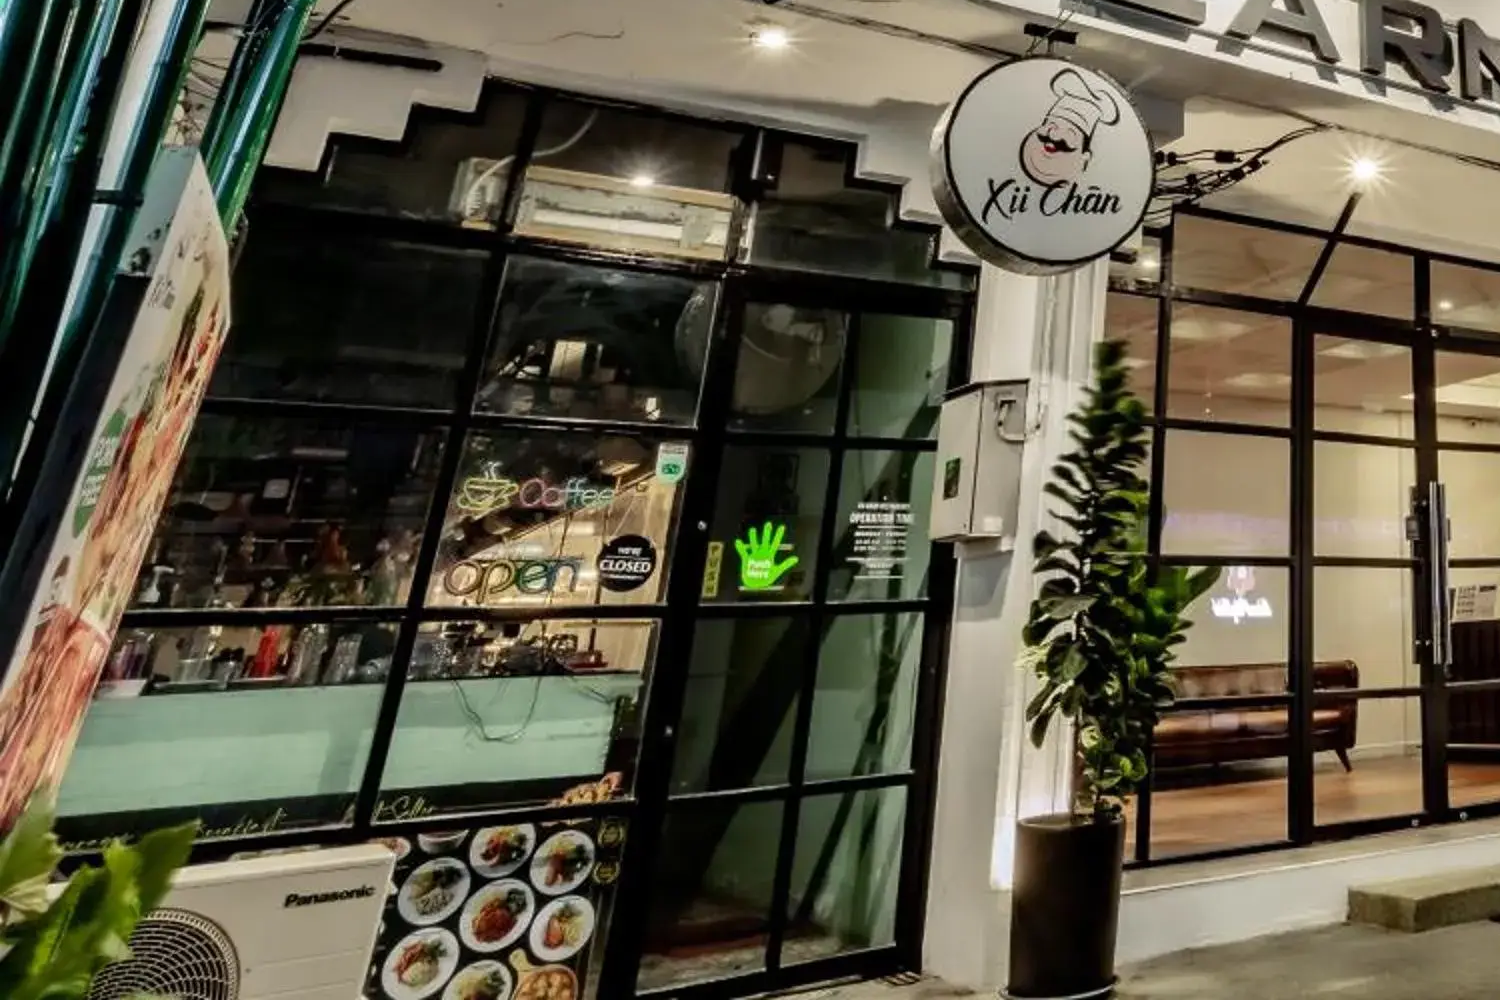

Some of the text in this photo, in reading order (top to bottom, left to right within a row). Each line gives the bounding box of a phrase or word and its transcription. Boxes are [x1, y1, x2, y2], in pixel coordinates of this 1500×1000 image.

[520, 476, 615, 508] Coffee
[600, 559, 650, 574] CLOSED
[444, 558, 579, 604] open
[283, 884, 375, 908] Panasonic
